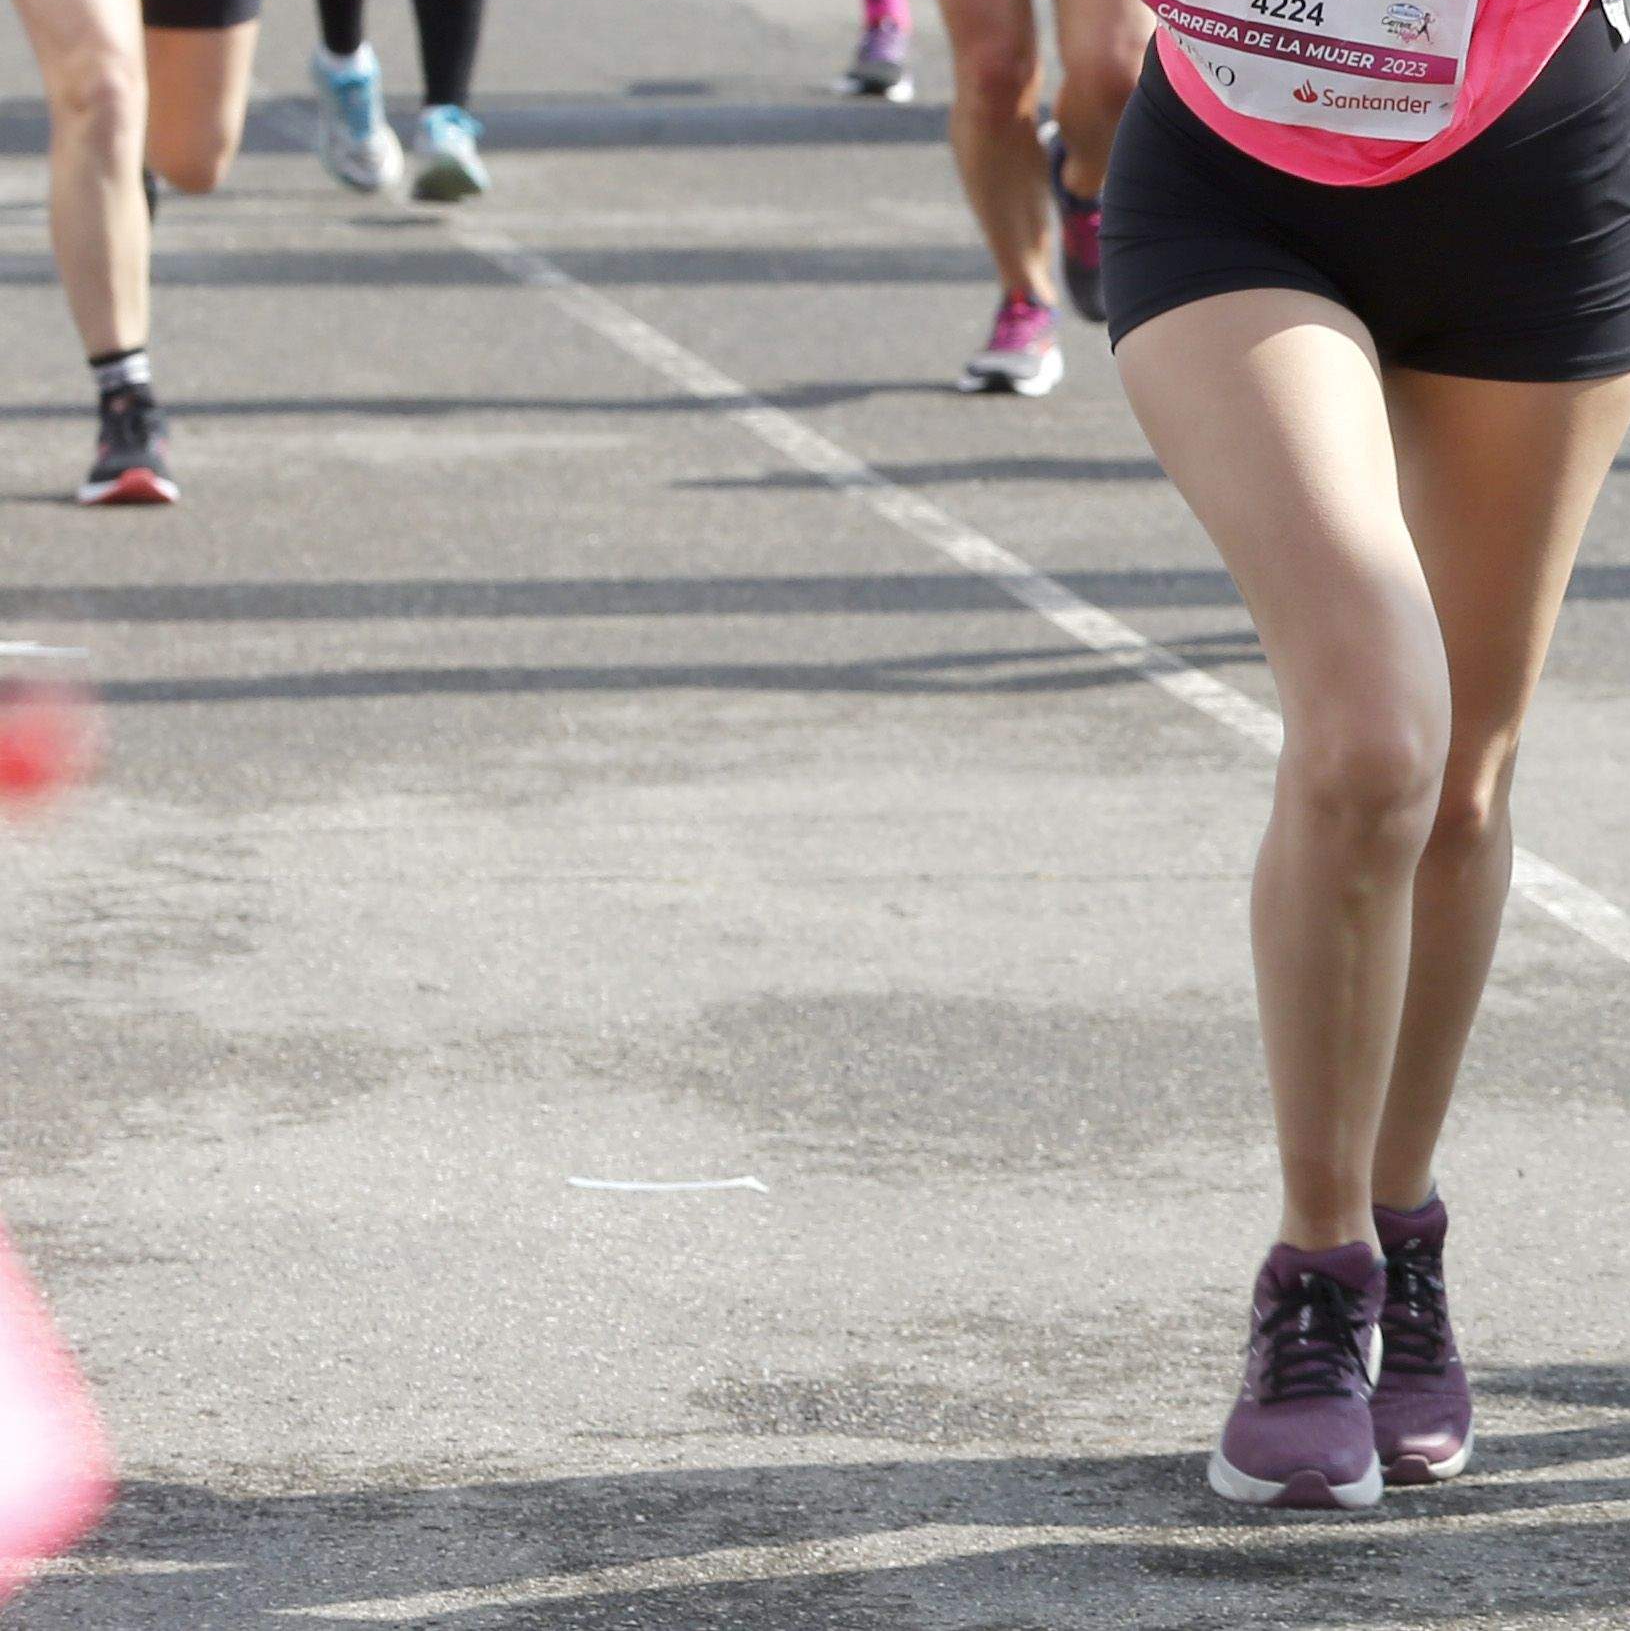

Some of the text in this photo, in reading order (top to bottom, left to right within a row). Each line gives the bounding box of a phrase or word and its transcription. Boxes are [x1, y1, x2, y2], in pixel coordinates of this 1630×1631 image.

[1157, 3, 1429, 78] CARRERA DE LA MUJER 2023
[1322, 89, 1432, 114] Santander
